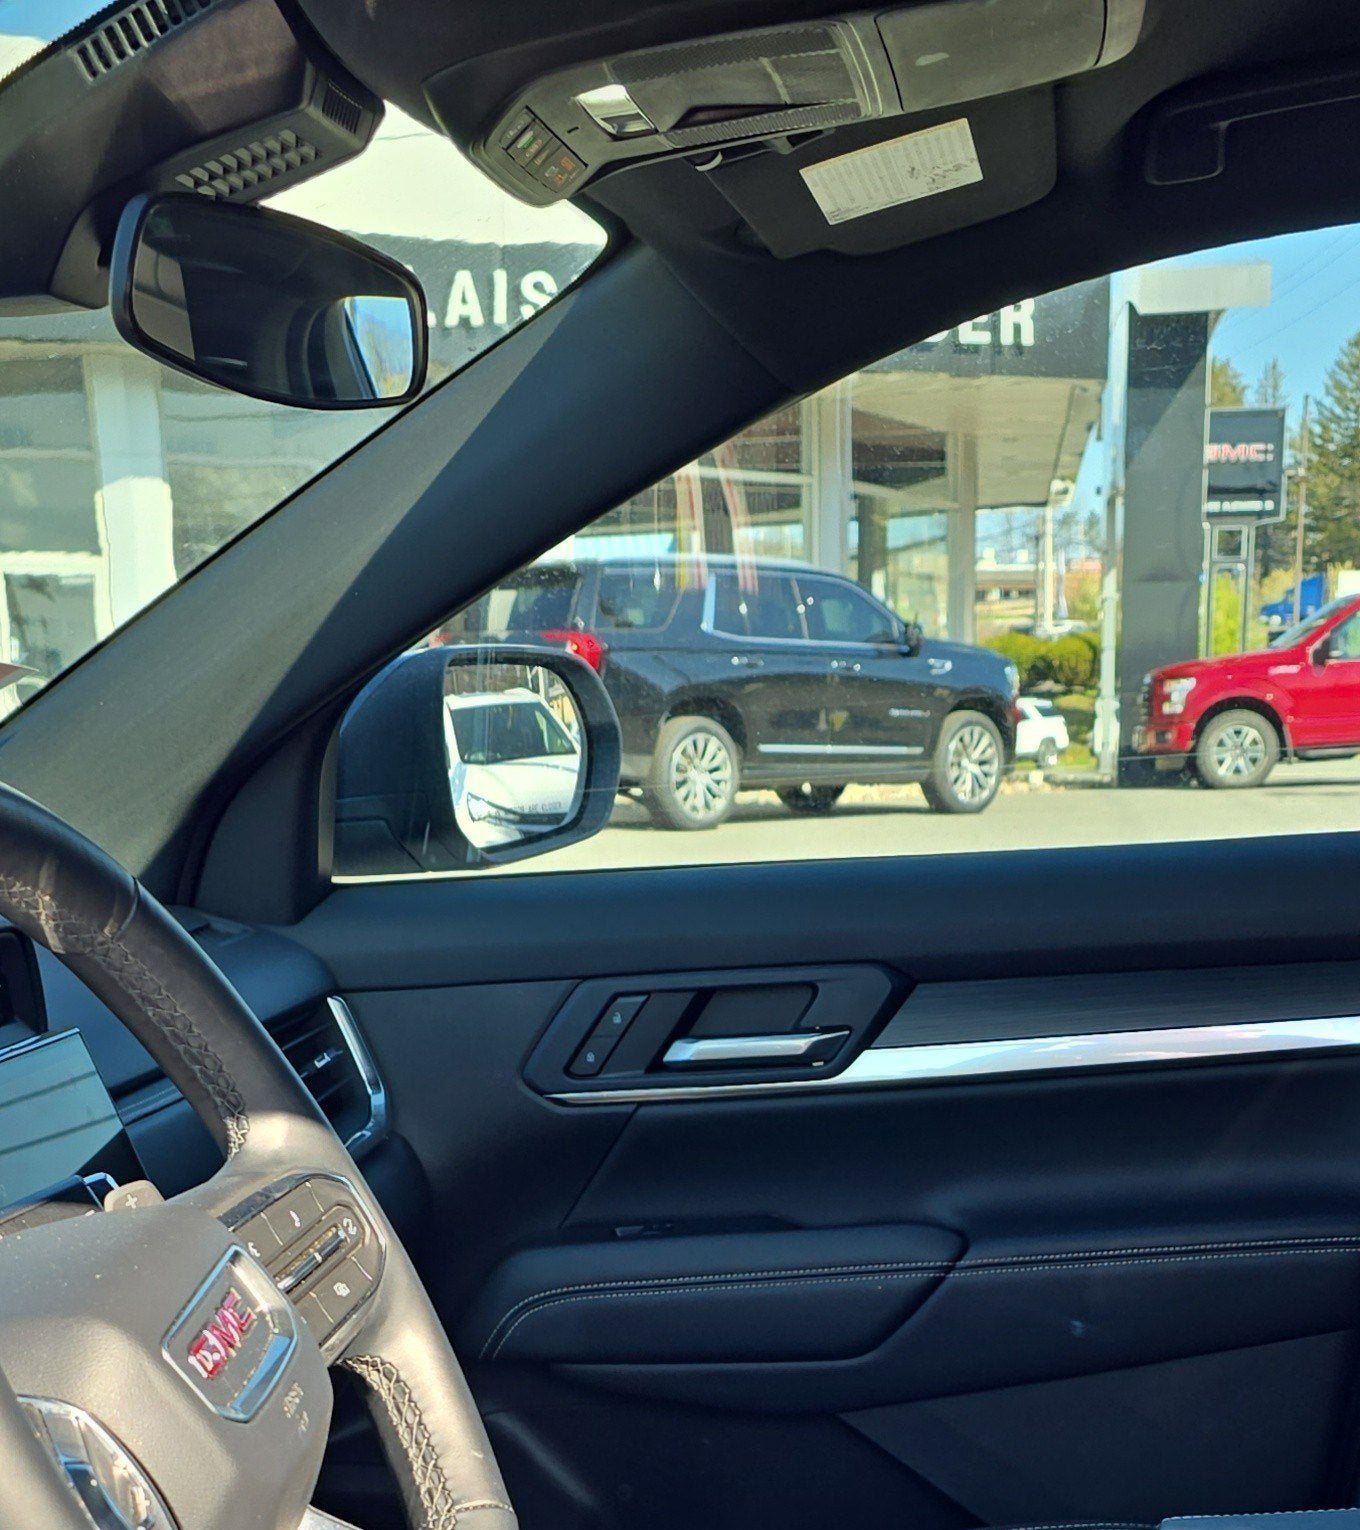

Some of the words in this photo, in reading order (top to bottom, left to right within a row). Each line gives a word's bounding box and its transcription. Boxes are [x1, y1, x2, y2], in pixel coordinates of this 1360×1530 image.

[428, 268, 580, 329] AIS
[923, 298, 1035, 347] ER
[188, 1288, 257, 1377] GMC
